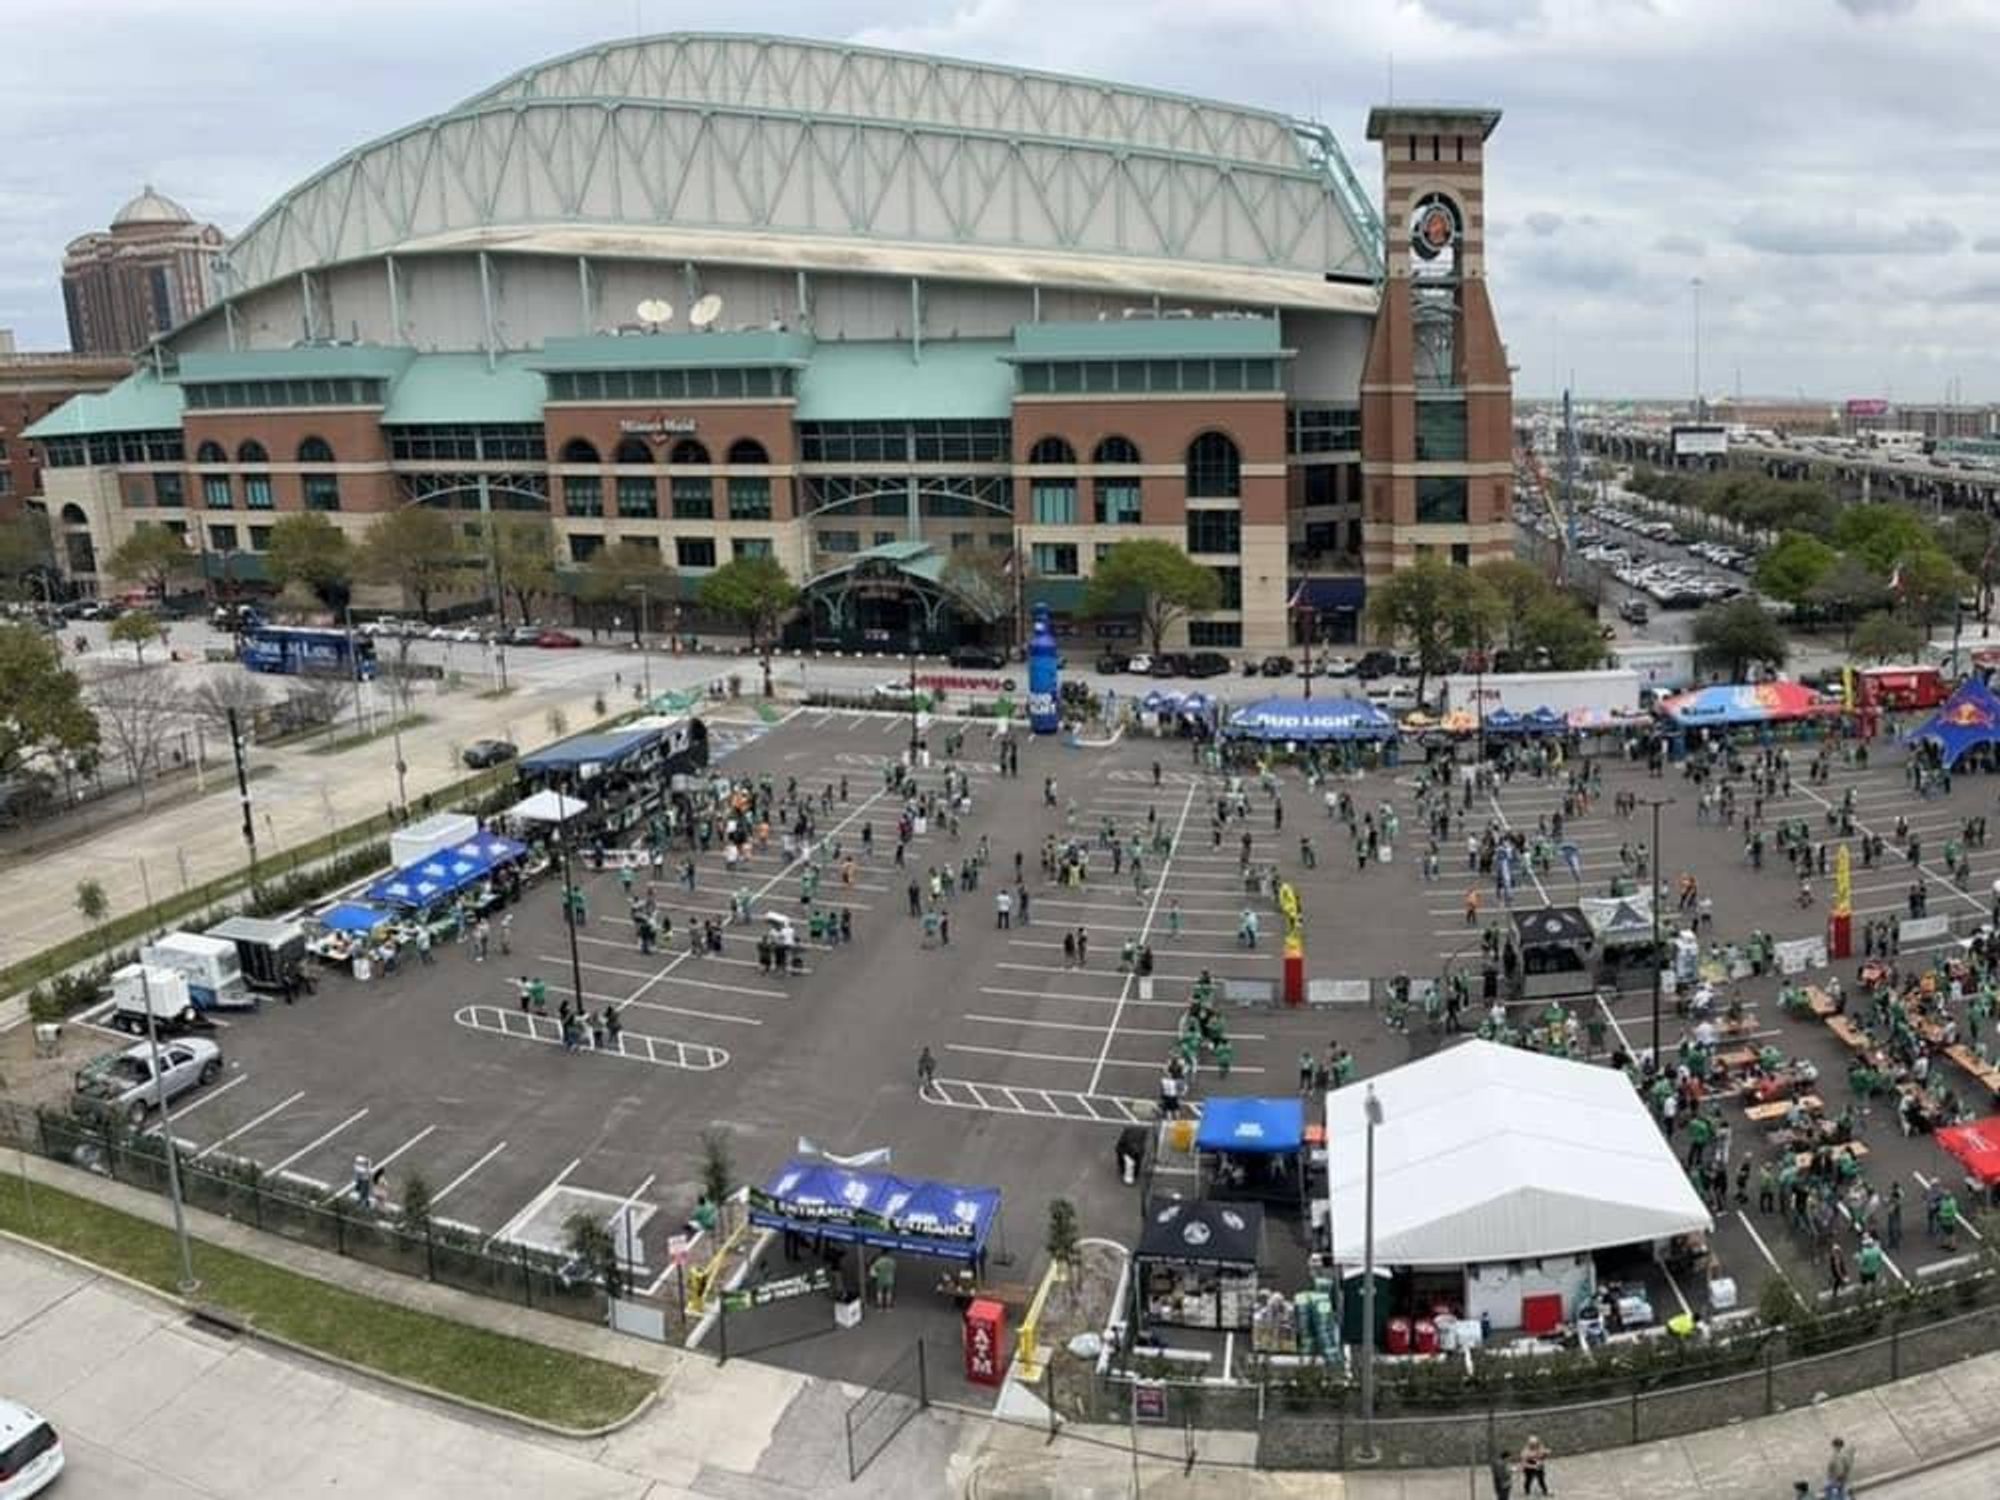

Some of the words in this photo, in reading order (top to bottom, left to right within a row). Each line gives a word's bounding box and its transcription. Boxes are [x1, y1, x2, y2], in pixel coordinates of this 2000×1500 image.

[1302, 713, 1362, 728] LIGHT
[779, 1201, 855, 1218] ENTRANCE
[894, 1216, 973, 1237] ENTRANCE
[972, 1327, 993, 1375] ATM
